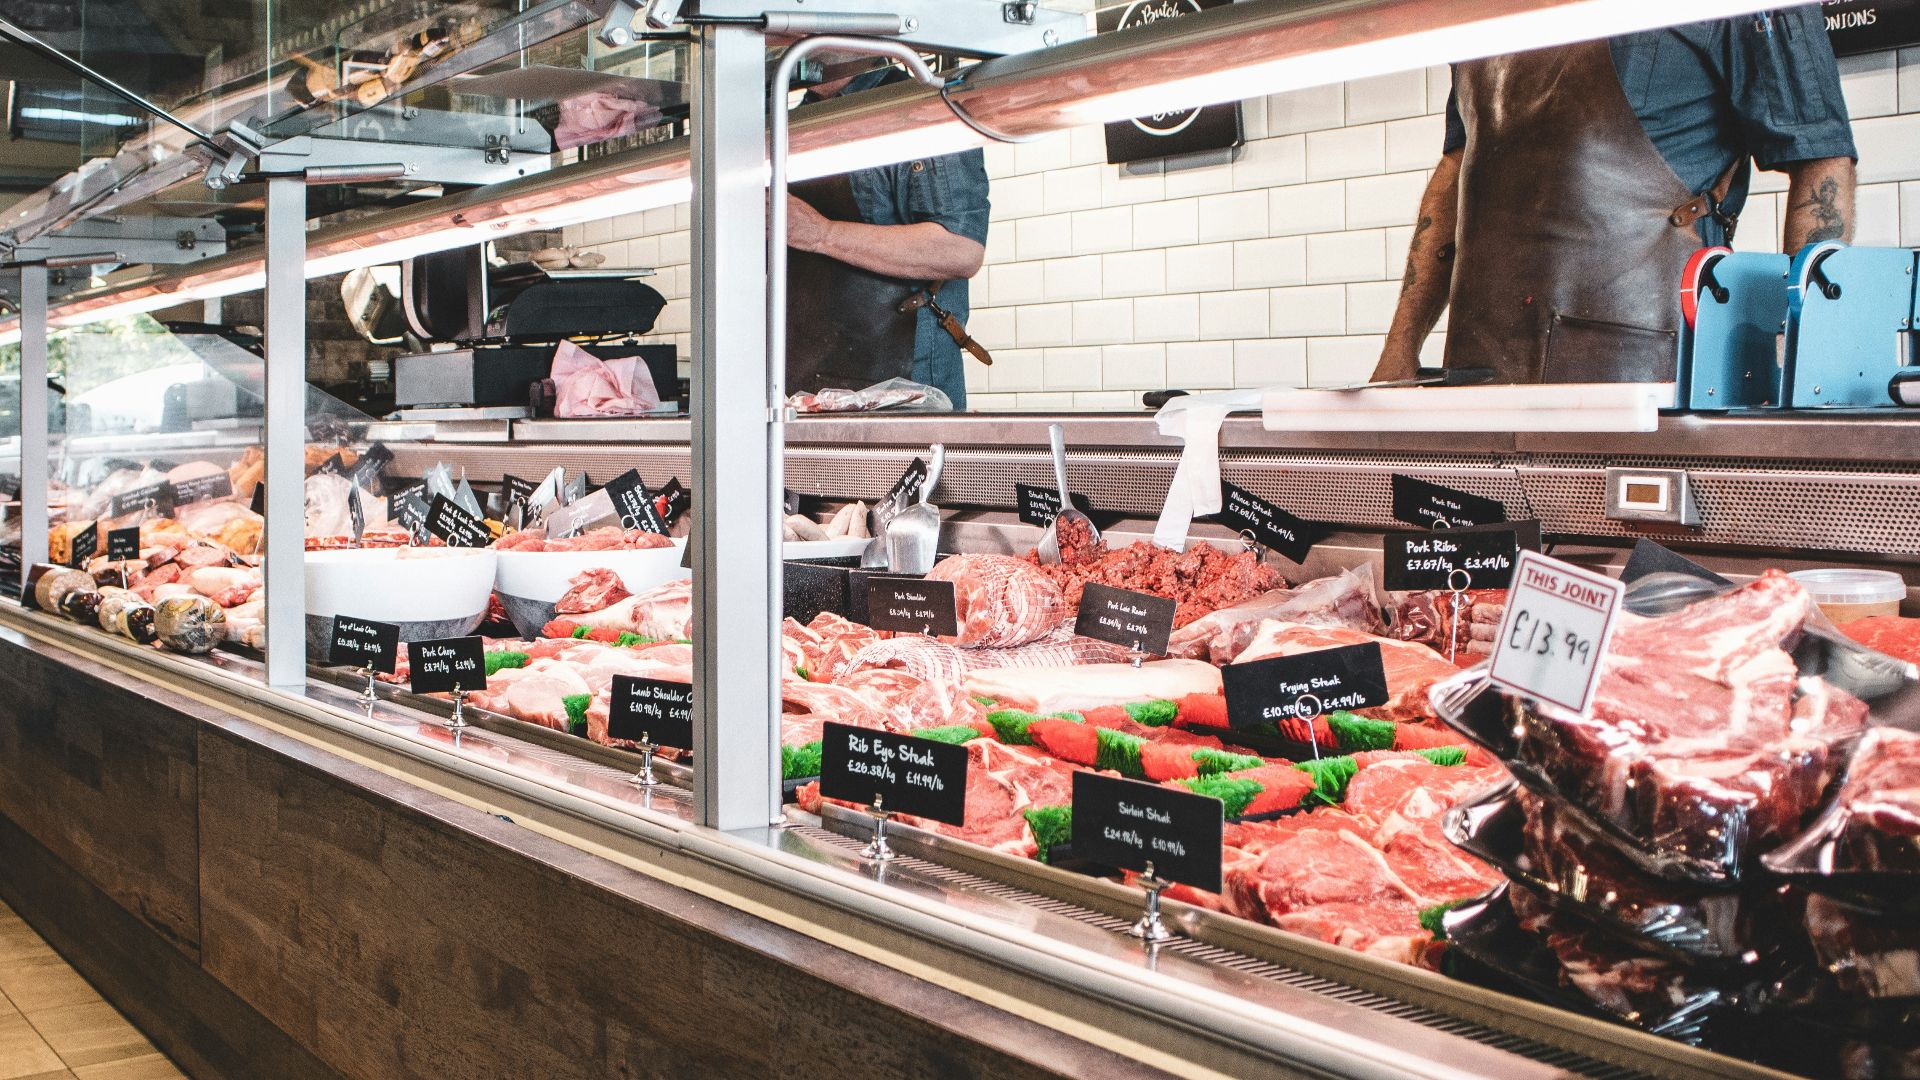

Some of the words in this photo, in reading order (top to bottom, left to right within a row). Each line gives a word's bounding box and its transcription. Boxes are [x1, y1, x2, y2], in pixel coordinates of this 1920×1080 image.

[1141, 1, 1184, 25] Butch
[1231, 491, 1250, 506] Mince
[1252, 501, 1272, 517] Steak
[1229, 503, 1260, 525] £7.68/kg
[1267, 521, 1295, 541] £3.49/lb
[1406, 540, 1430, 553] Pork
[1433, 540, 1457, 552] Ribs
[1406, 556, 1453, 572] £7.67/kg
[1464, 554, 1509, 569] £3.49/lb
[894, 592, 905, 600] Pork
[1526, 568, 1558, 591] THIS
[1562, 581, 1608, 608] JOINT
[1108, 600, 1118, 610] Pork
[1510, 610, 1589, 665] £13.99
[422, 646, 436, 658] Pork
[438, 646, 456, 658] Chops
[631, 683, 651, 697] Lamb
[654, 687, 684, 702] Shoulder
[1280, 682, 1309, 694] Frying
[1310, 675, 1341, 688] Steak
[1323, 692, 1366, 710] £4.99/lb
[669, 708, 692, 721] £4.99/l
[849, 734, 868, 753] Rib
[874, 739, 895, 763] Eye
[899, 745, 934, 767] Steak
[847, 760, 895, 783] £26.38/kg
[906, 771, 944, 791] £11.99/lb
[1118, 801, 1144, 819] Sirloin
[1146, 807, 1172, 824] Steak
[1152, 837, 1185, 857] £10.99/lb
